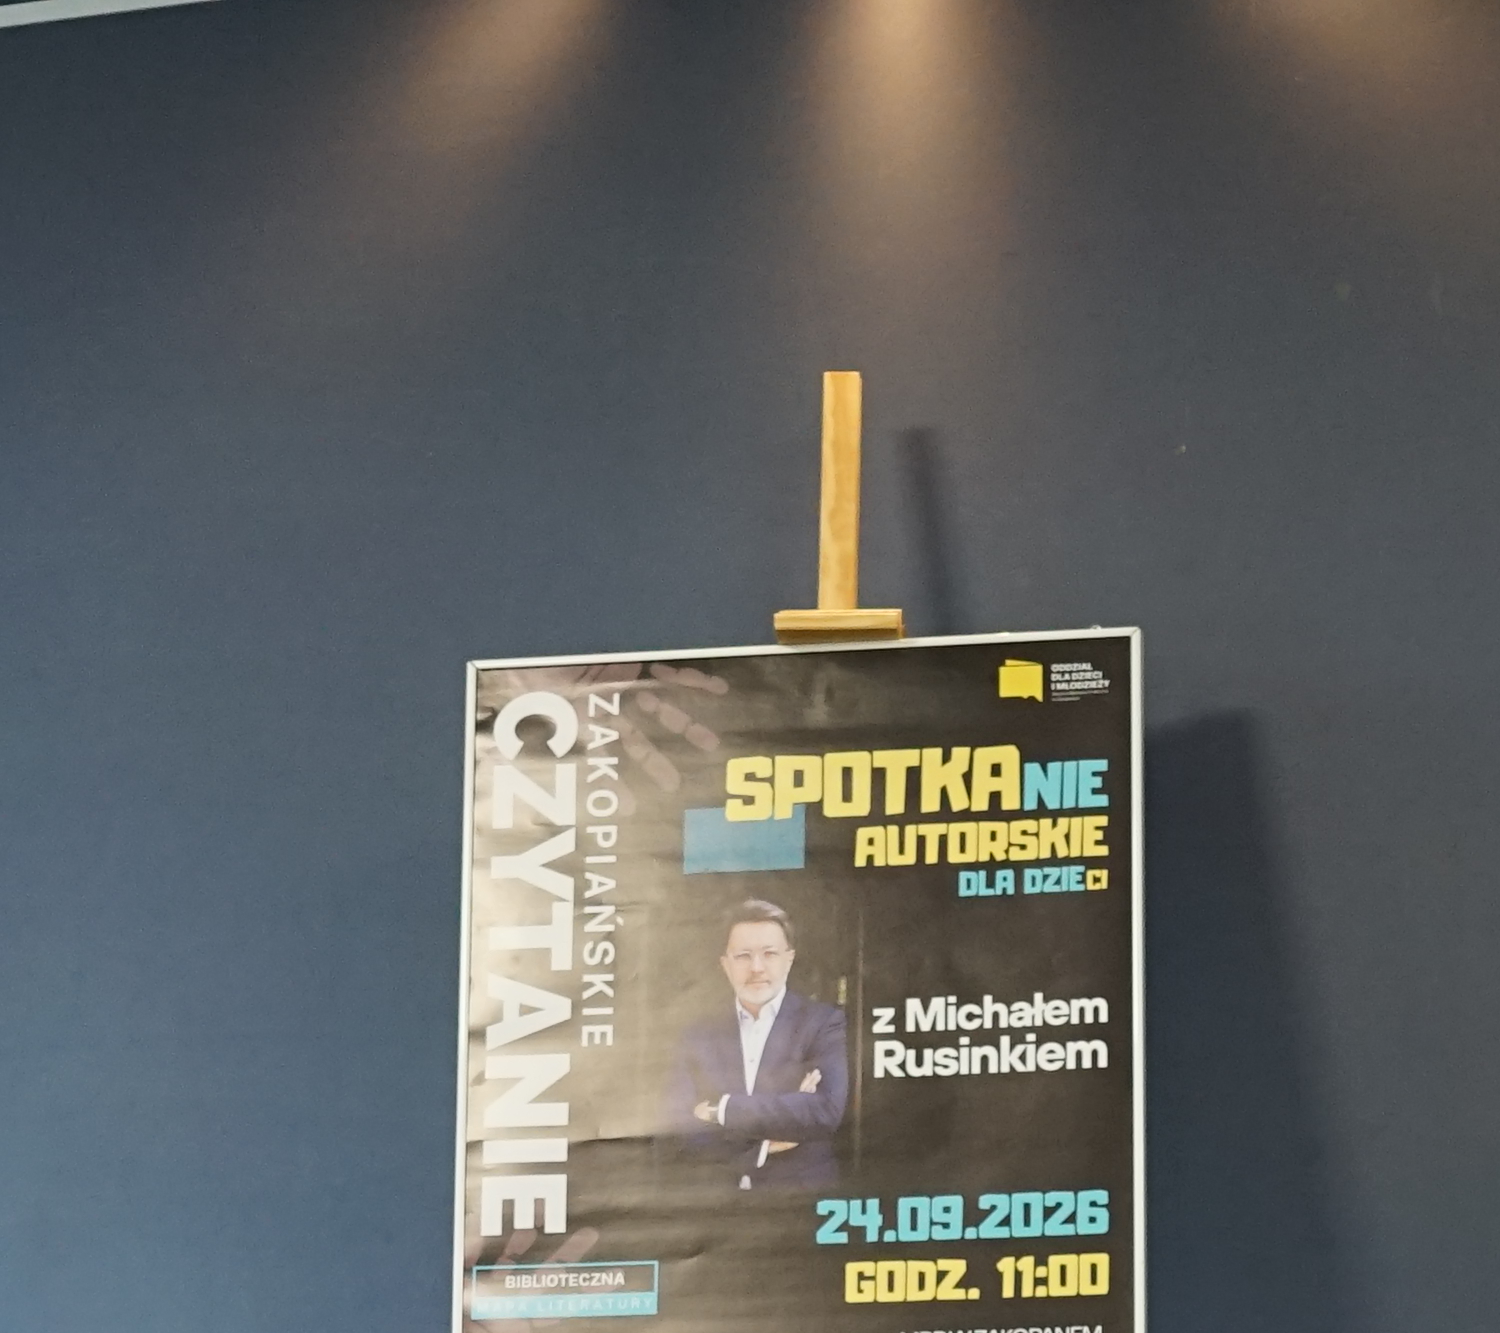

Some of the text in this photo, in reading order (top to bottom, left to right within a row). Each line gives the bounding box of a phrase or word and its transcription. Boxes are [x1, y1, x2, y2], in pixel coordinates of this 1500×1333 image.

[725, 744, 1109, 822] SPOTKANIE
[854, 815, 1109, 867] AUTORSKIE
[581, 692, 623, 1047] ZAKOPIAŃSKIE
[958, 865, 1109, 898] DLA DZIECI
[480, 691, 579, 1236] CZYTANIE
[872, 992, 1109, 1034] z Michałem
[873, 1033, 1109, 1078] Rusinkiem
[815, 1189, 1110, 1245] 24.09.2026
[504, 1271, 626, 1289] BIBLIOTECZNA
[844, 1253, 1110, 1304] GODZ. 11:00
